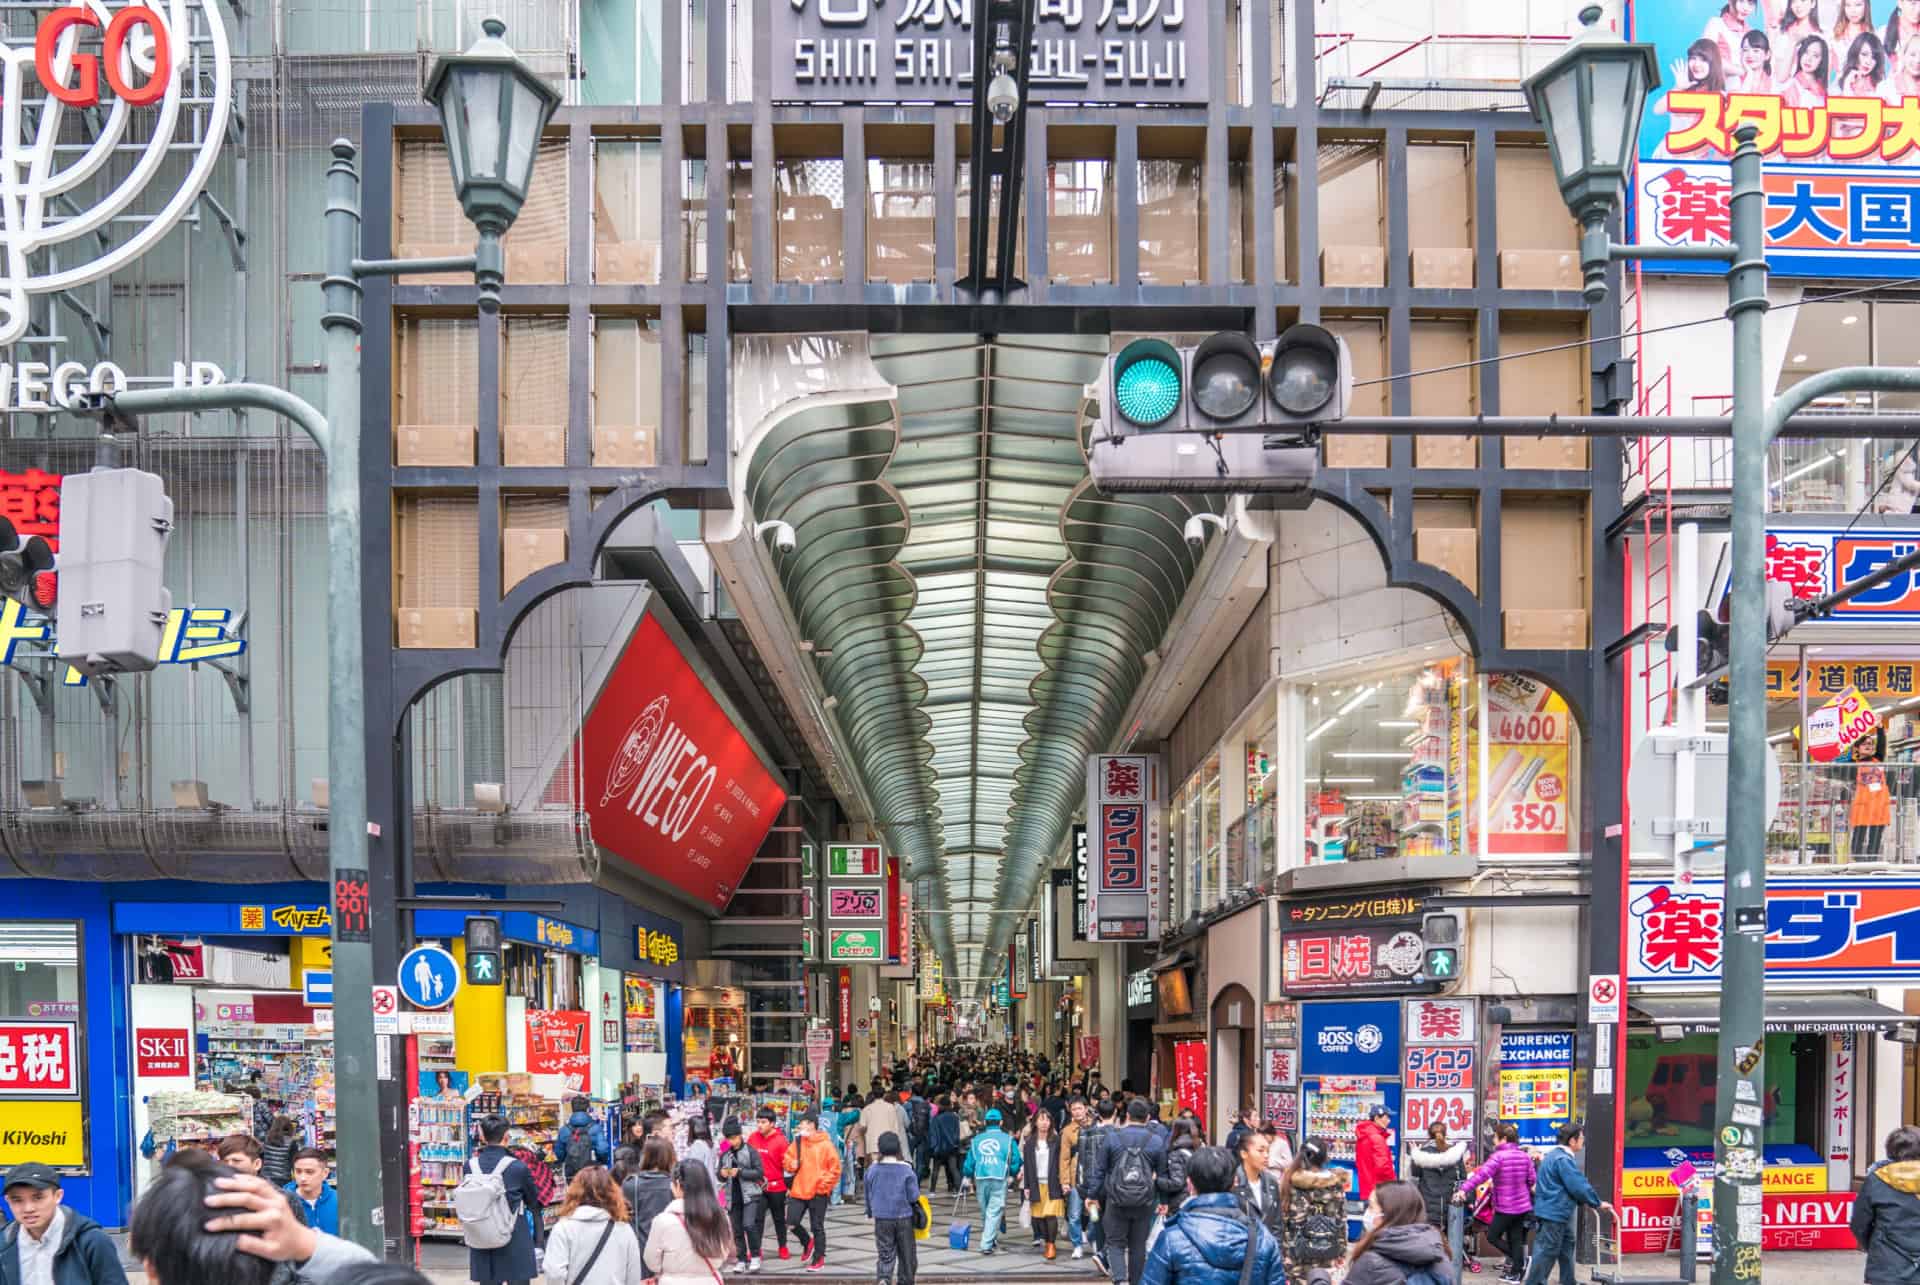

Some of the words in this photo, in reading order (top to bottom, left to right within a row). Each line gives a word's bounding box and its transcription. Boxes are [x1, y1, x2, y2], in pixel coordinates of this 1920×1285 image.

[35, 6, 171, 106] GO
[1661, 170, 1732, 243] 薬
[1767, 182, 1920, 243] 大国
[1501, 715, 1556, 741] 4600
[1838, 710, 1876, 745] 4600
[627, 721, 718, 842] WEGO
[1107, 759, 1140, 798] 薬
[1511, 803, 1556, 832] 350
[1108, 807, 1138, 887] ダイコク
[335, 879, 369, 897] 064
[240, 905, 265, 929] 薬
[271, 904, 331, 930] マツモト
[1645, 897, 1723, 972] 薬
[1299, 933, 1372, 979] 日焼
[1418, 1002, 1462, 1039] 薬
[1762, 1022, 1786, 1032] AVI
[1794, 1022, 1876, 1033] INFORMATION
[1317, 1031, 1354, 1046] BOSS
[1320, 1045, 1349, 1053] COFFEE
[1501, 1034, 1569, 1047] CURRENCY
[1408, 1049, 1473, 1071] ダイコク
[1501, 1048, 1570, 1062] EXCHANGE
[1414, 1071, 1463, 1089] ドラッグ
[3, 1130, 67, 1146] KiYoshi
[1762, 1173, 1815, 1185] HANGE
[1775, 1201, 1854, 1225] NAVI
